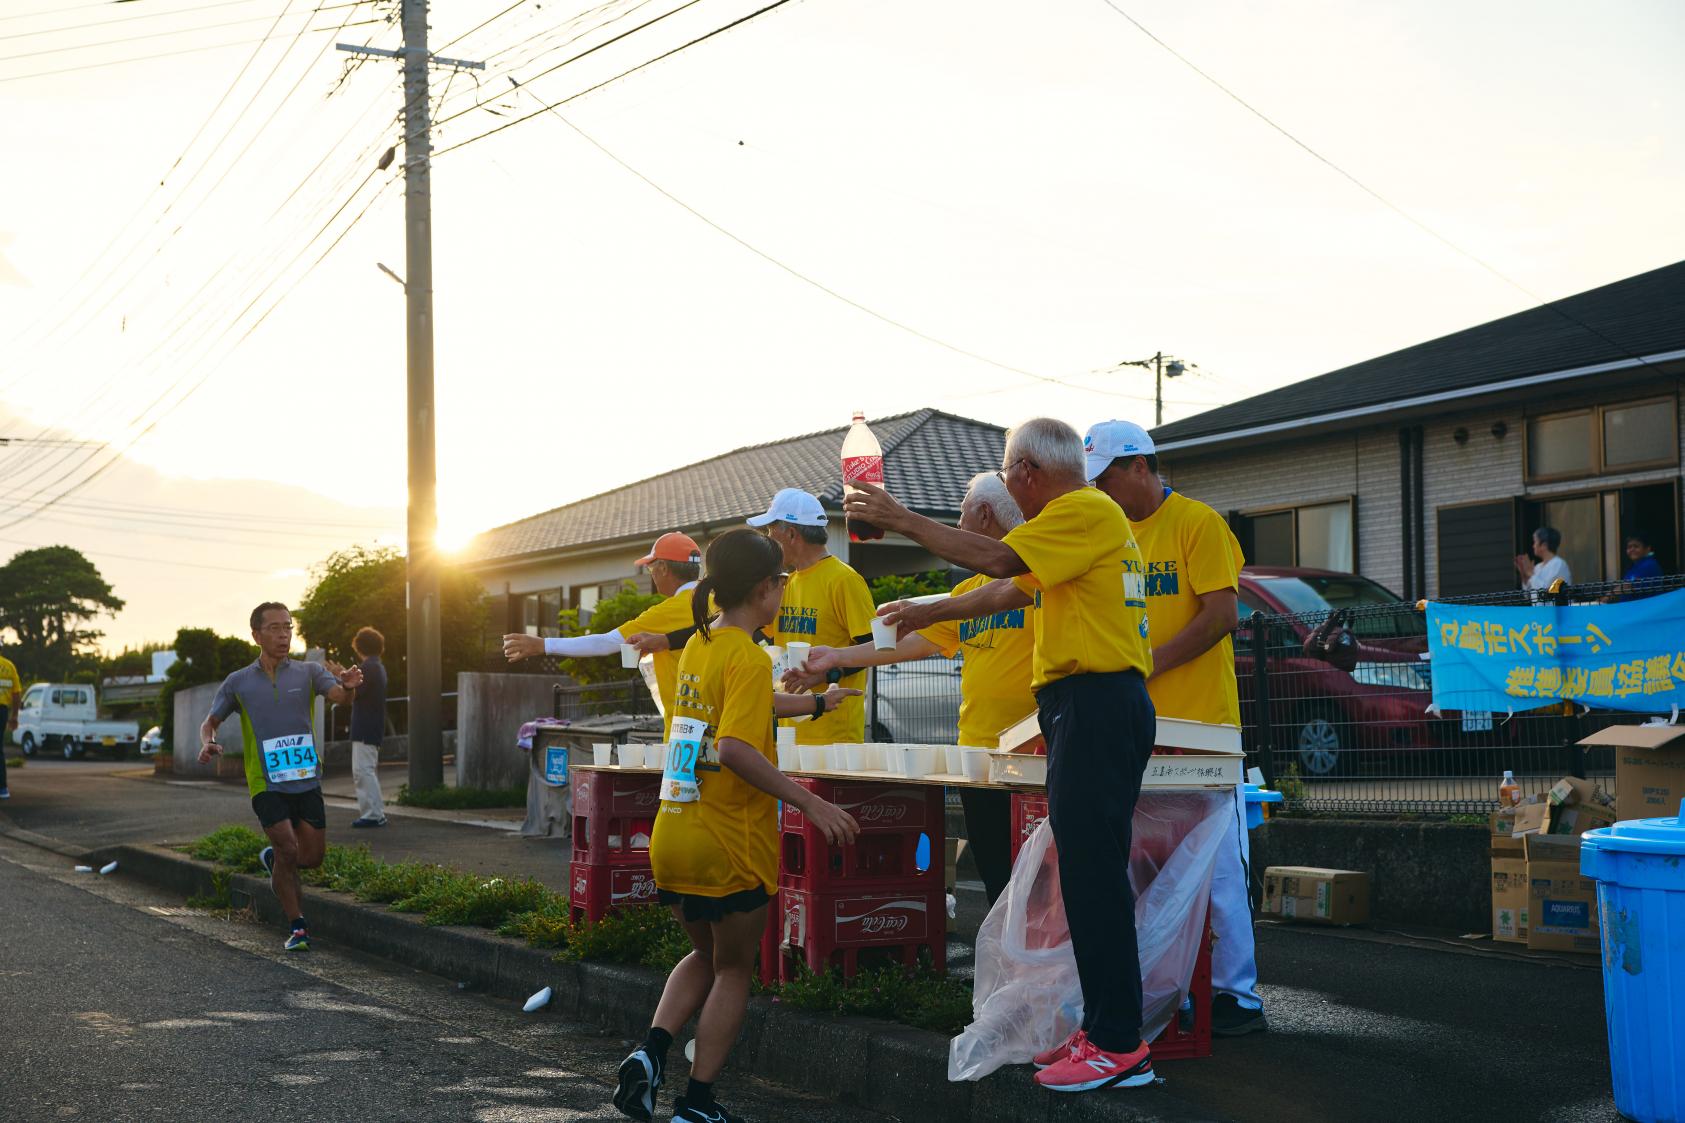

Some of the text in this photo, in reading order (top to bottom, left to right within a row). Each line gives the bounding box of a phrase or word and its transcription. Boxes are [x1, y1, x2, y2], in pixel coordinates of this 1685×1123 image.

[276, 739, 296, 748] ANA
[268, 747, 314, 768] 3154
[860, 914, 909, 933] Coca-Cola
